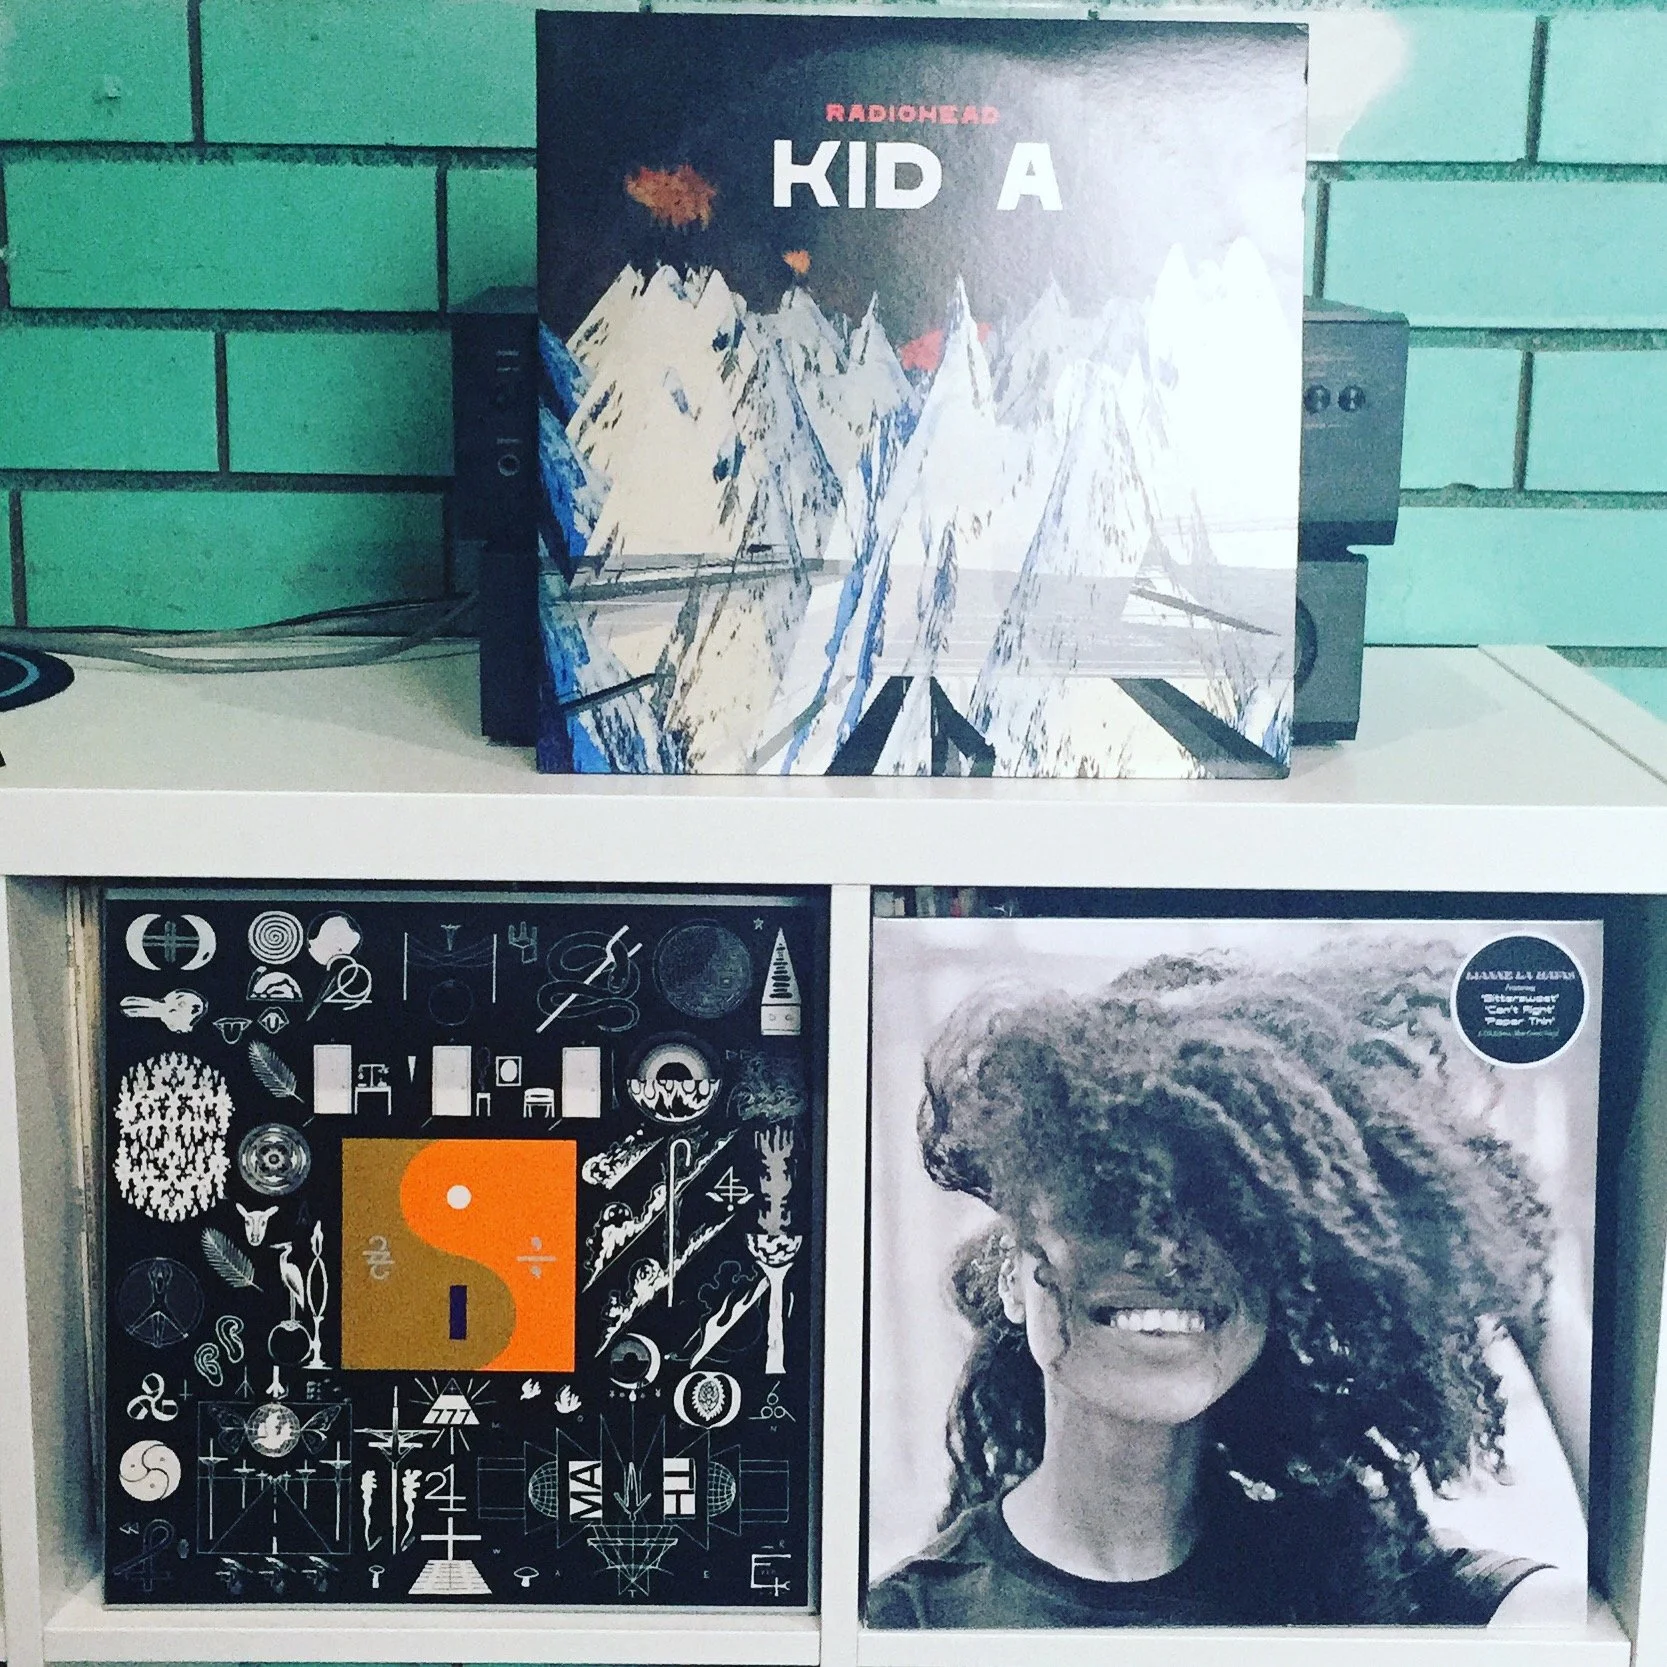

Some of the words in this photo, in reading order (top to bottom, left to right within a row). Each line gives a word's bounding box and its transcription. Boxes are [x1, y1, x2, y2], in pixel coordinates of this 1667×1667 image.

[825, 103, 1001, 125] RADIOHEAD
[773, 139, 943, 211] KID
[996, 142, 1063, 211] A
